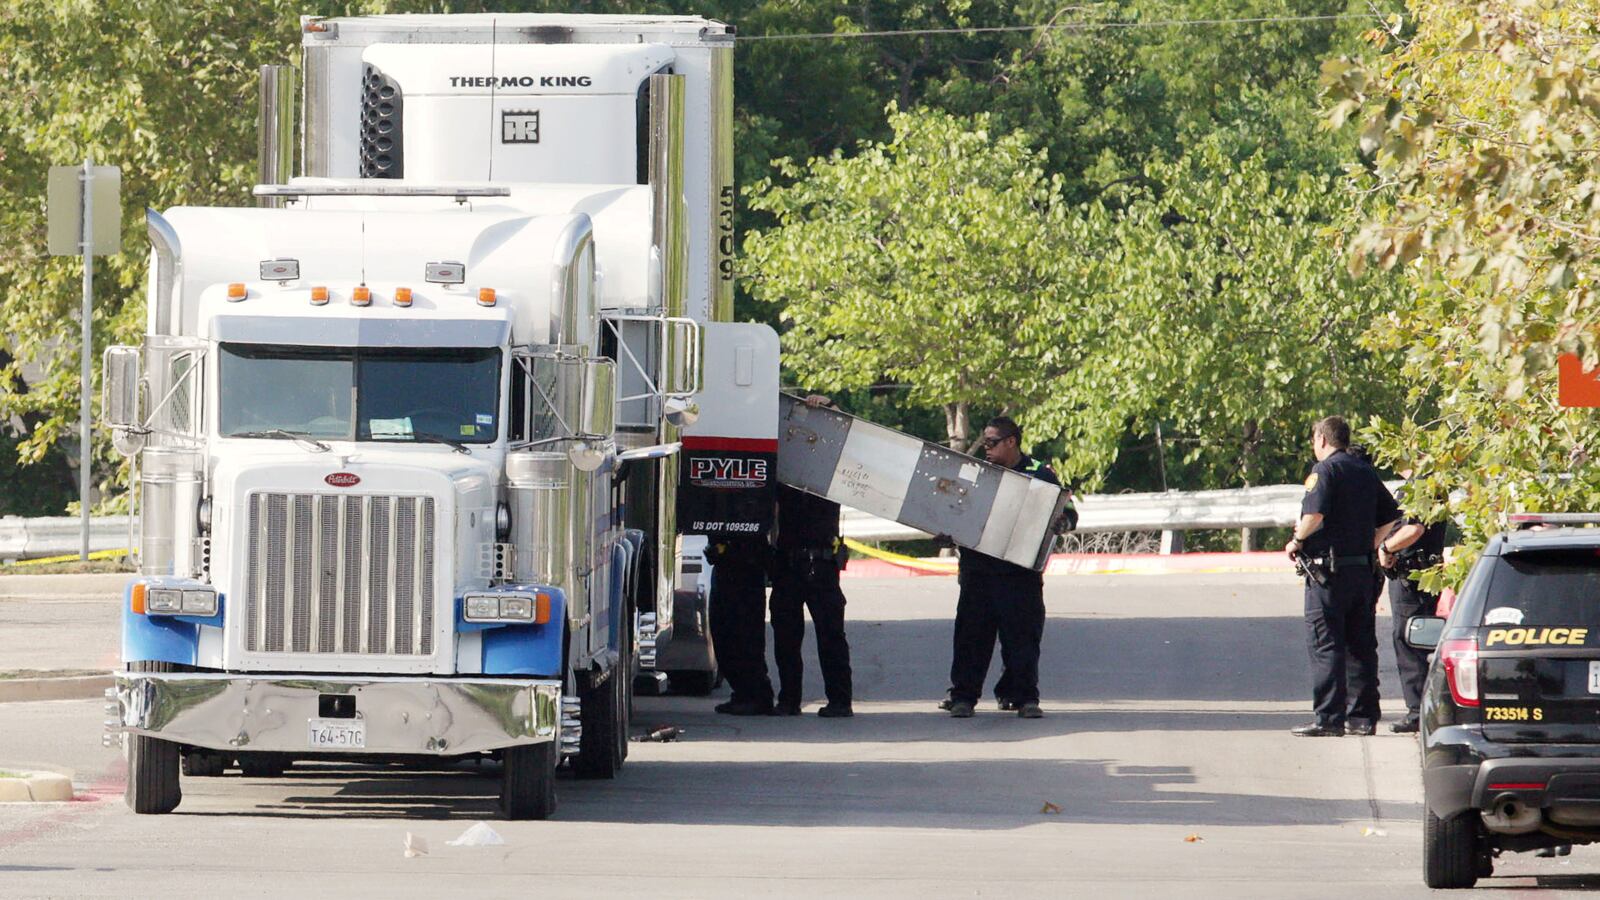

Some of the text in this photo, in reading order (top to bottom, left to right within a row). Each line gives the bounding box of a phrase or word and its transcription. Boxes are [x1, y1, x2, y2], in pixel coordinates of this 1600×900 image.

[449, 76, 592, 88] THERMO KING
[689, 457, 767, 481] PYLE
[692, 521, 760, 532] US DOT 1095286
[1486, 628, 1588, 646] POLICE
[1485, 707, 1543, 720] 733514 S
